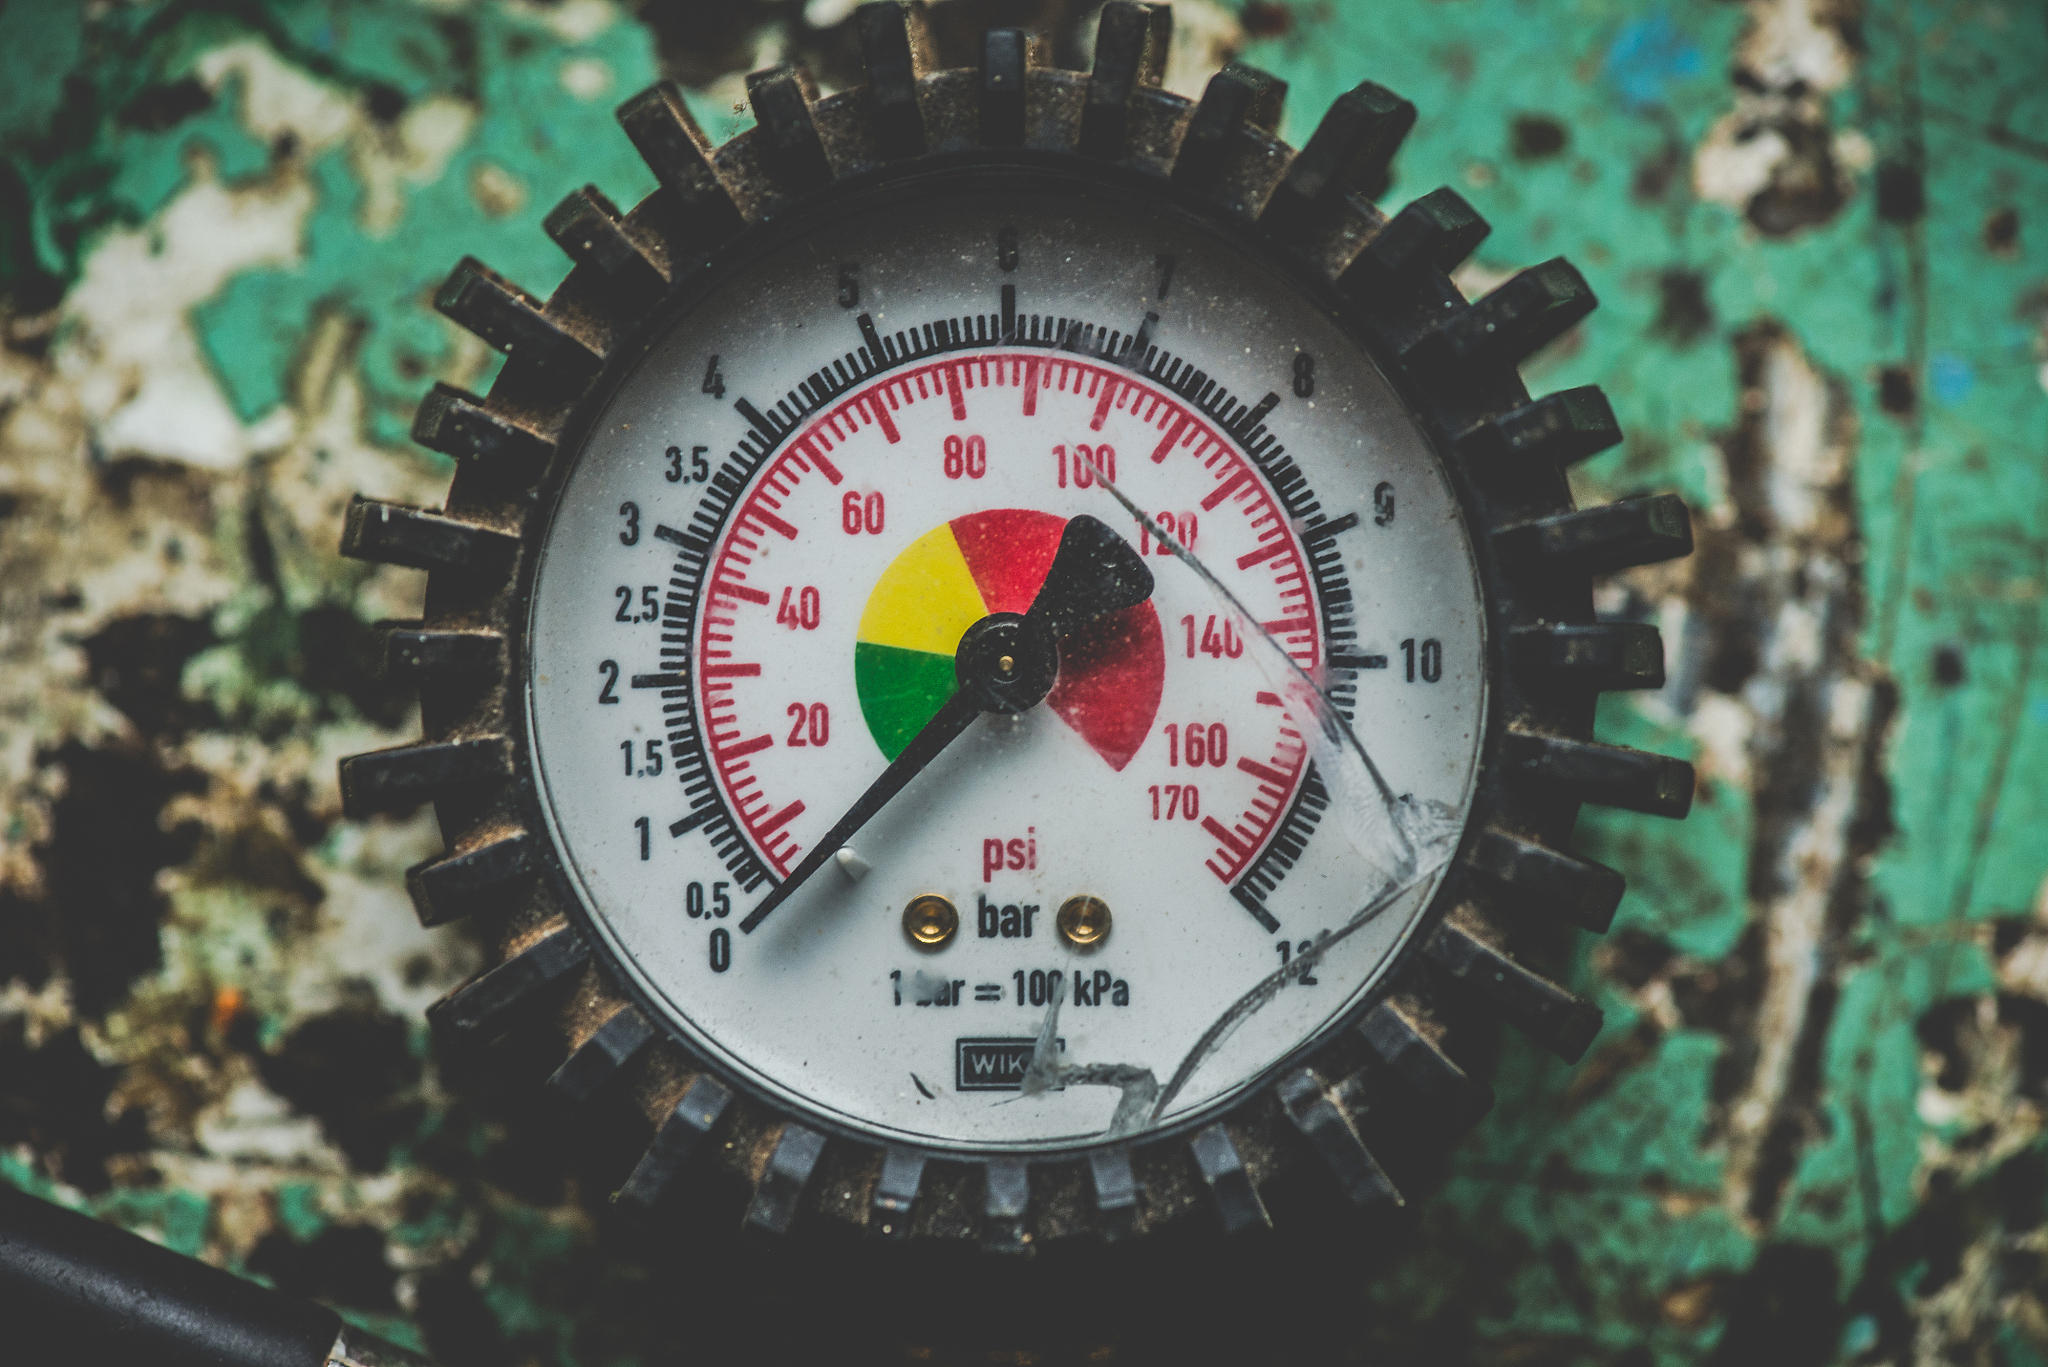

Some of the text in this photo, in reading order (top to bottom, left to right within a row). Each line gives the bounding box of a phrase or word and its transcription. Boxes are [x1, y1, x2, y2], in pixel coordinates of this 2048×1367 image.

[999, 226, 1018, 272] 6
[839, 263, 860, 309] 5
[1155, 254, 1176, 300] 7
[702, 355, 726, 399] 4
[1293, 353, 1314, 398] 8
[943, 434, 986, 479] 80
[1052, 444, 1116, 489] 100
[619, 502, 640, 546] 3
[842, 491, 885, 535] 60
[1374, 481, 1395, 527] 9
[1134, 511, 1198, 556] 120
[776, 586, 820, 630] 40
[1180, 614, 1244, 659] 140
[599, 659, 620, 704] 2
[1400, 638, 1442, 683] 10
[787, 702, 829, 747] 20
[1164, 722, 1228, 768] 160
[1148, 784, 1199, 821] 170
[634, 816, 650, 861] 1
[983, 826, 1036, 883] psi
[978, 893, 1040, 938] bar
[710, 927, 731, 973] 0
[974, 985, 1001, 1001] =
[1074, 970, 1130, 1007] kPa
